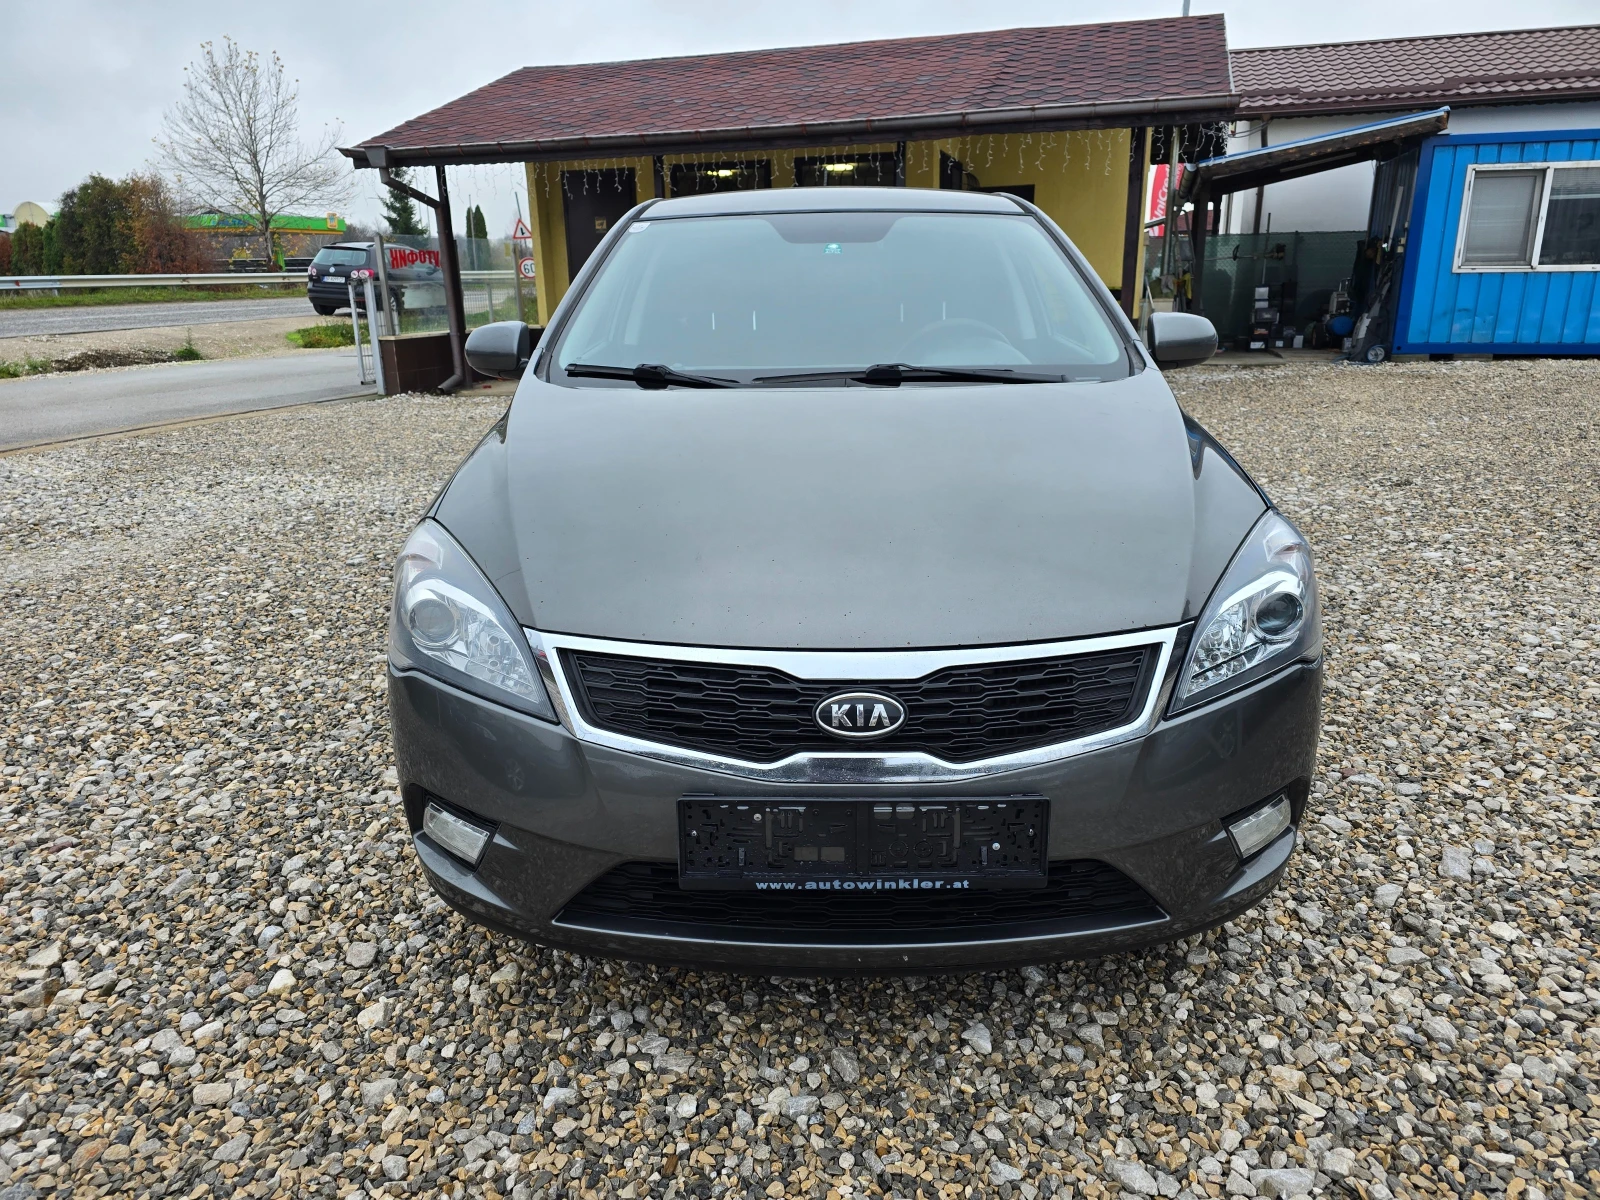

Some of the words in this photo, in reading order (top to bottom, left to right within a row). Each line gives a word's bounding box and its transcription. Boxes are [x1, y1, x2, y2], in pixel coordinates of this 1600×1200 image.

[523, 262, 536, 275] 60
[830, 703, 891, 727] KIA
[755, 878, 970, 890] www.autowinkler.at
